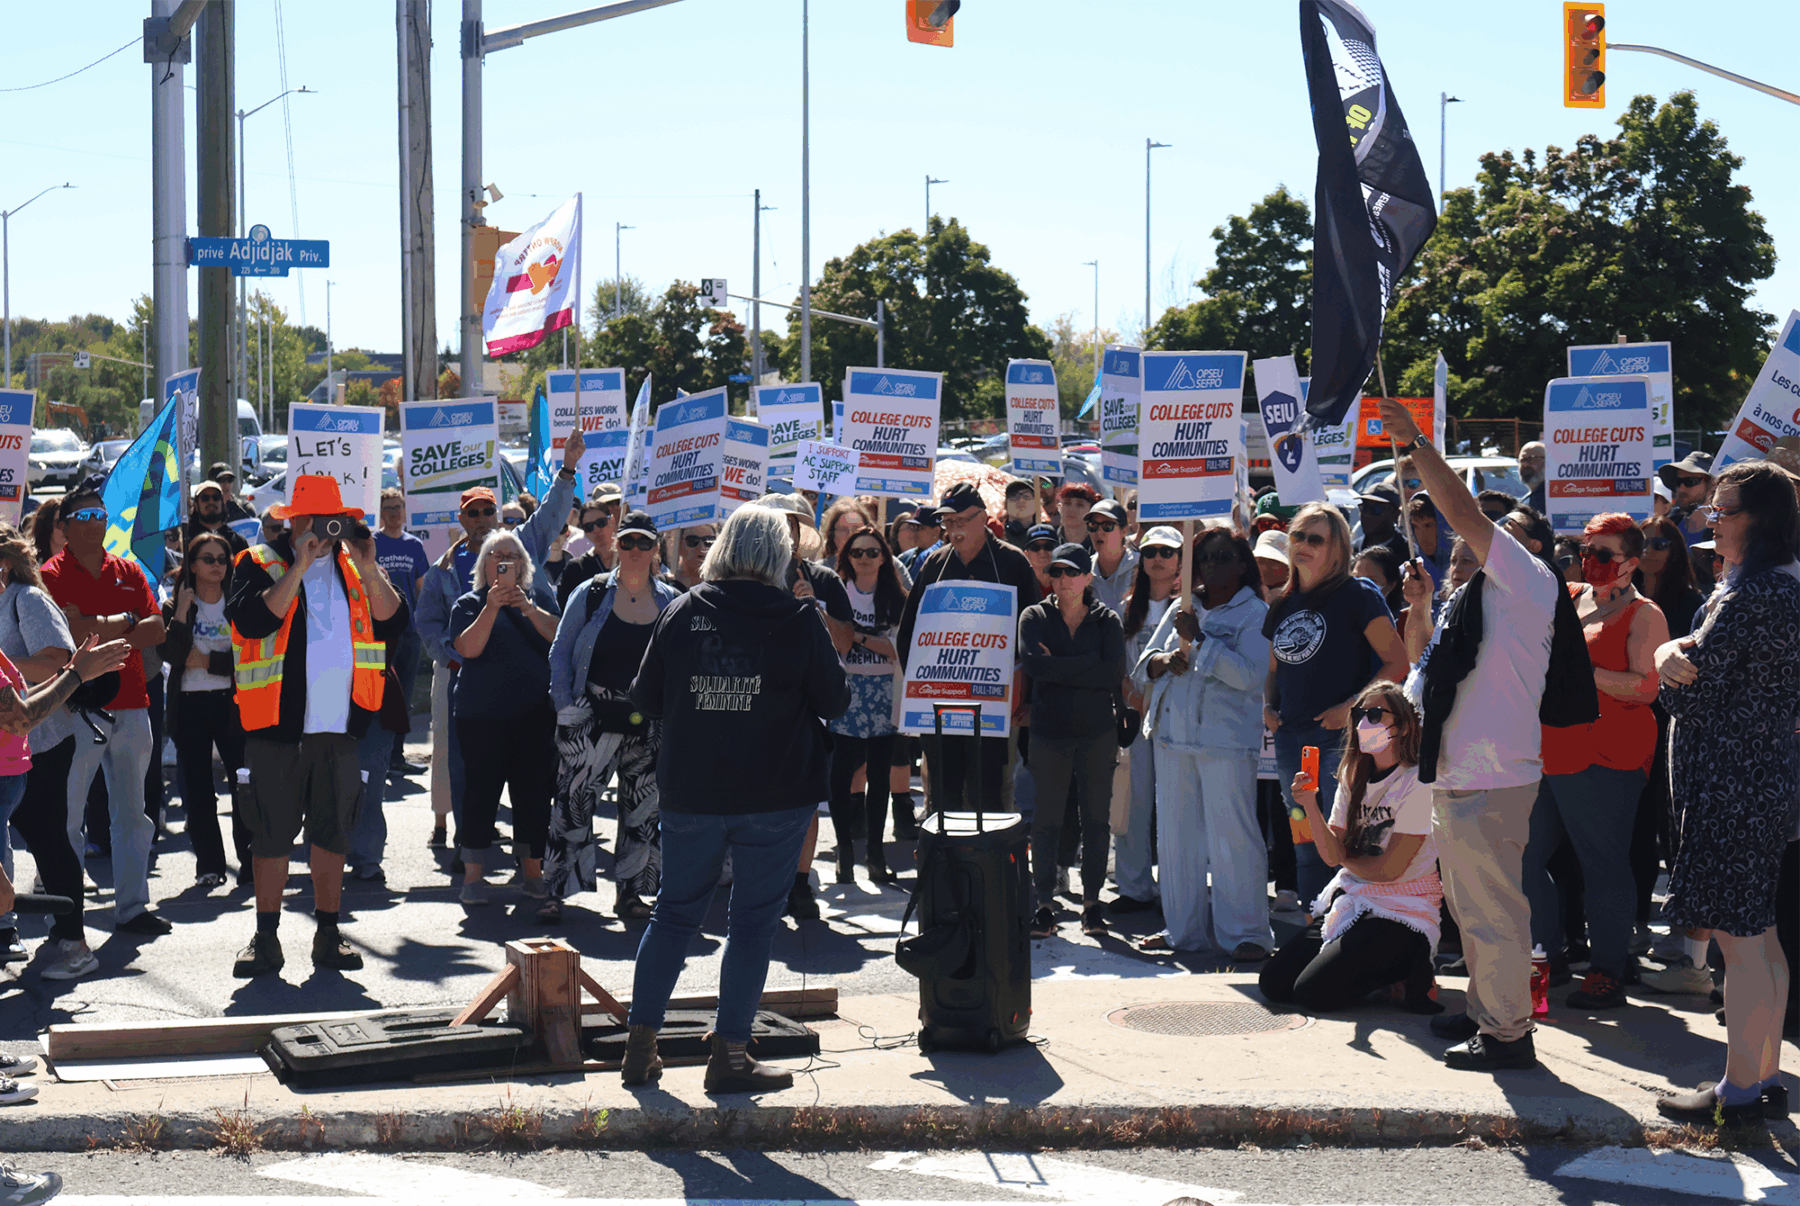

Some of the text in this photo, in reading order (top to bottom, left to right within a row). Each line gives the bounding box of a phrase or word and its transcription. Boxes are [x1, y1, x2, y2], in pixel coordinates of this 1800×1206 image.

[197, 241, 322, 265] privé Adjidjàk Priv.
[1620, 356, 1650, 366] OPSEU
[1620, 364, 1649, 373] SEFPO
[1196, 368, 1224, 379] OPSEU
[1771, 369, 1791, 389] Les
[895, 383, 916, 391] OPSEU
[1196, 378, 1223, 389] SEFPO
[1010, 397, 1055, 410] COLLEGE CUTS
[1595, 400, 1621, 408] SEFPO
[1596, 393, 1621, 401] OPSEU
[555, 404, 618, 417] COLLGES WORK
[1103, 398, 1125, 416] SAVE
[1149, 402, 1234, 421] COLLEGE CUTS
[1265, 402, 1295, 425] SEIU
[582, 416, 604, 431] WE
[605, 418, 621, 429] do!
[851, 410, 932, 429] COLLEGE CUTS
[1023, 410, 1043, 423] HURT
[1753, 403, 1783, 430] à nos
[771, 420, 822, 445] OLLEGES!
[872, 426, 910, 441] HURT
[1013, 422, 1054, 435] COMMUNITIES
[1174, 421, 1212, 440] HURT
[1553, 427, 1645, 444] COLLEGE CUTS
[0, 434, 23, 449] UTS
[295, 436, 351, 457] LET'S
[656, 437, 693, 459] COLLEGE
[694, 432, 720, 449] CUTS
[852, 438, 927, 455] COMMUNITIES
[1152, 440, 1228, 458] COMMUNITIES
[411, 440, 462, 463] SAVE
[670, 450, 701, 470] HURT
[809, 444, 850, 459] I SUPPORT
[1579, 445, 1620, 462] HURT
[739, 458, 762, 470] WORK
[802, 455, 856, 474] AC SUPPORT
[902, 457, 929, 468] FULL-TIME
[1156, 458, 1230, 475] College Support FULL-TIME
[1558, 462, 1641, 478] COMMUNITIES
[655, 463, 714, 487] COMMUNITIES
[724, 466, 761, 486] WE do!
[1562, 480, 1644, 494] College Support FULL-TIME
[378, 553, 414, 563] Catherine
[961, 596, 987, 605] OPSEU
[961, 603, 986, 611] SEFPO
[917, 632, 1008, 649] COLLEGE CUTS
[937, 648, 980, 666] HURT
[915, 665, 1001, 682] COMMUNITIES
[690, 674, 761, 694] SOLIDARITÉ
[918, 683, 1003, 696] College Support FULL-TIME
[695, 693, 752, 711] FEMININE
